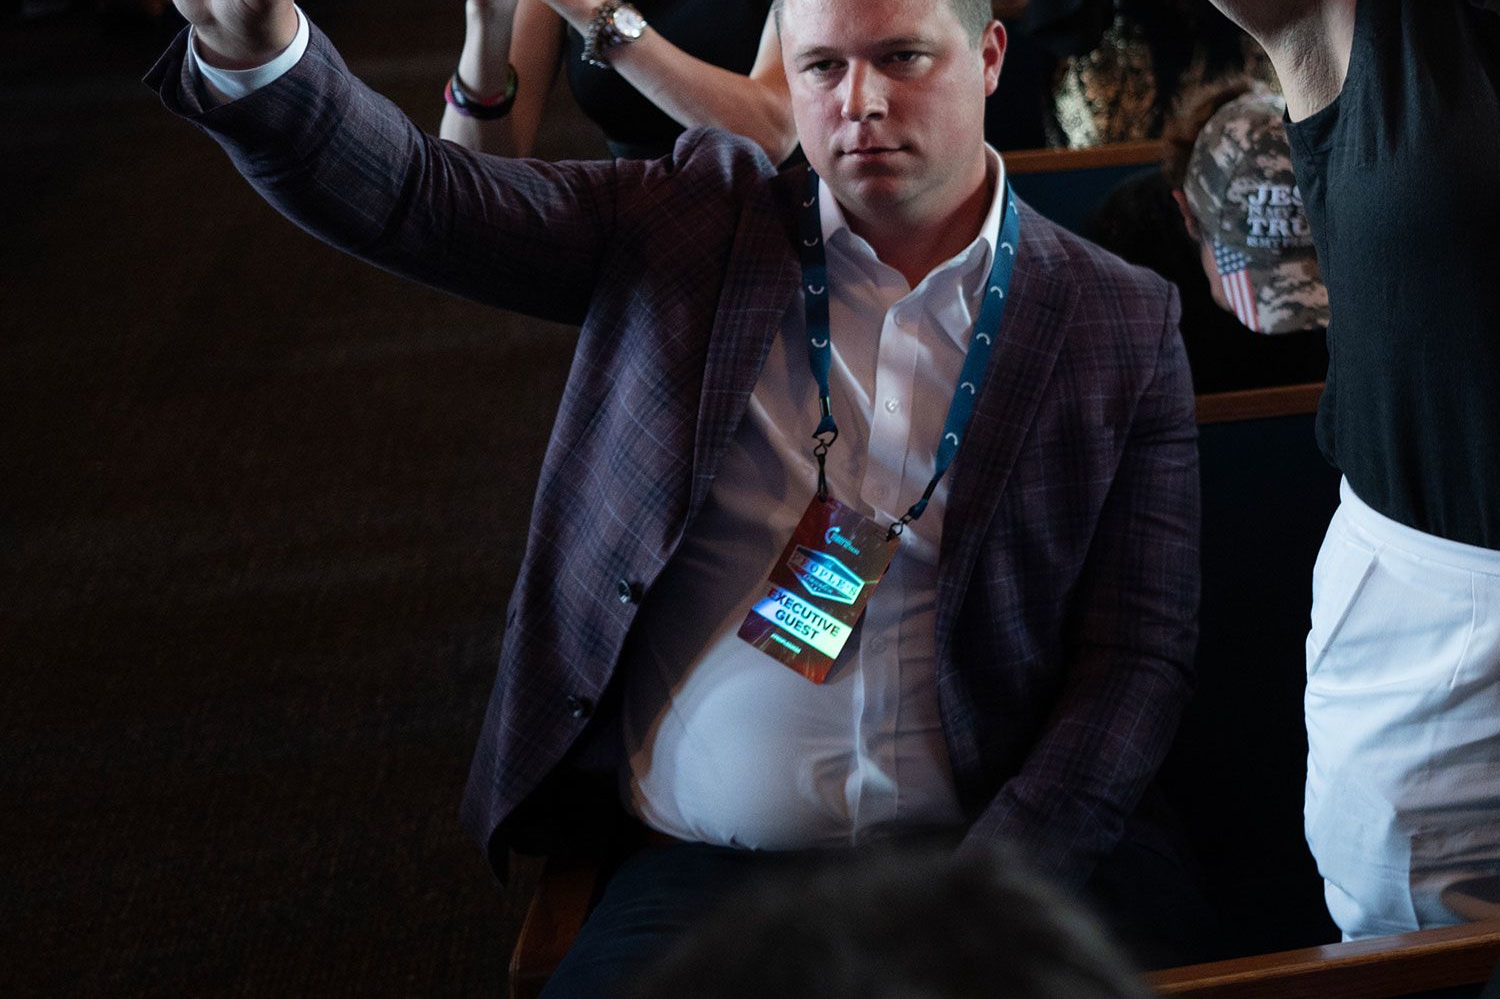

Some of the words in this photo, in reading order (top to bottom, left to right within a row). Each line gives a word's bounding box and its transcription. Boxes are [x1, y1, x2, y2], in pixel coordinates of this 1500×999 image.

[1248, 185, 1303, 207] JES
[1247, 218, 1311, 236] TRU
[775, 608, 820, 640] GUEST
